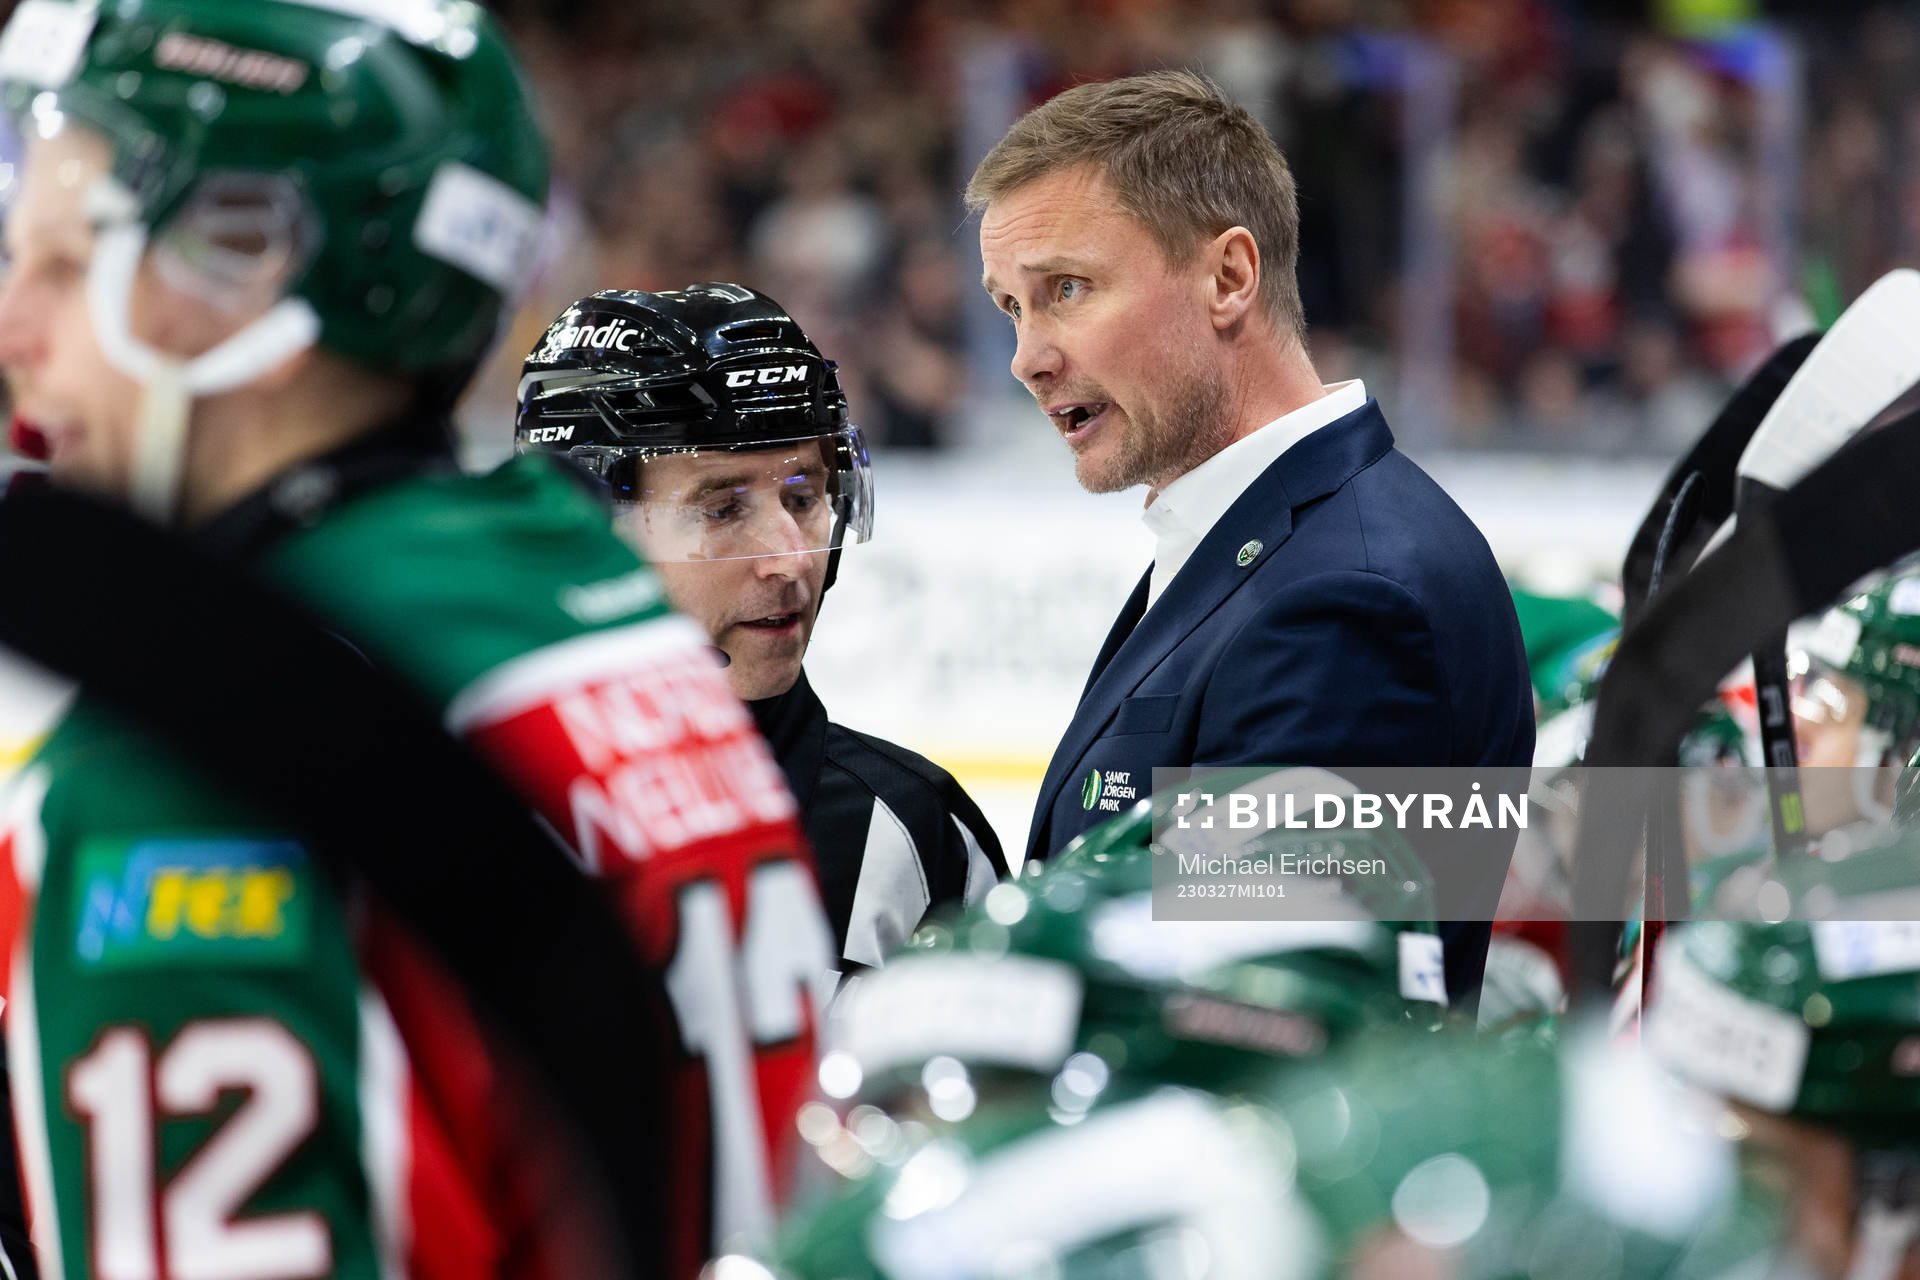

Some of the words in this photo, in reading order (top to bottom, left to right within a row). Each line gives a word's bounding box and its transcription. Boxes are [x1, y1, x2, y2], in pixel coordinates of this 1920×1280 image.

[724, 365, 809, 389] CCM
[529, 425, 575, 443] CCM
[1104, 770, 1131, 784] SANKT
[1102, 781, 1137, 800] JÖRGEN
[1099, 798, 1120, 812] PARK
[66, 1015, 333, 1280] 12
